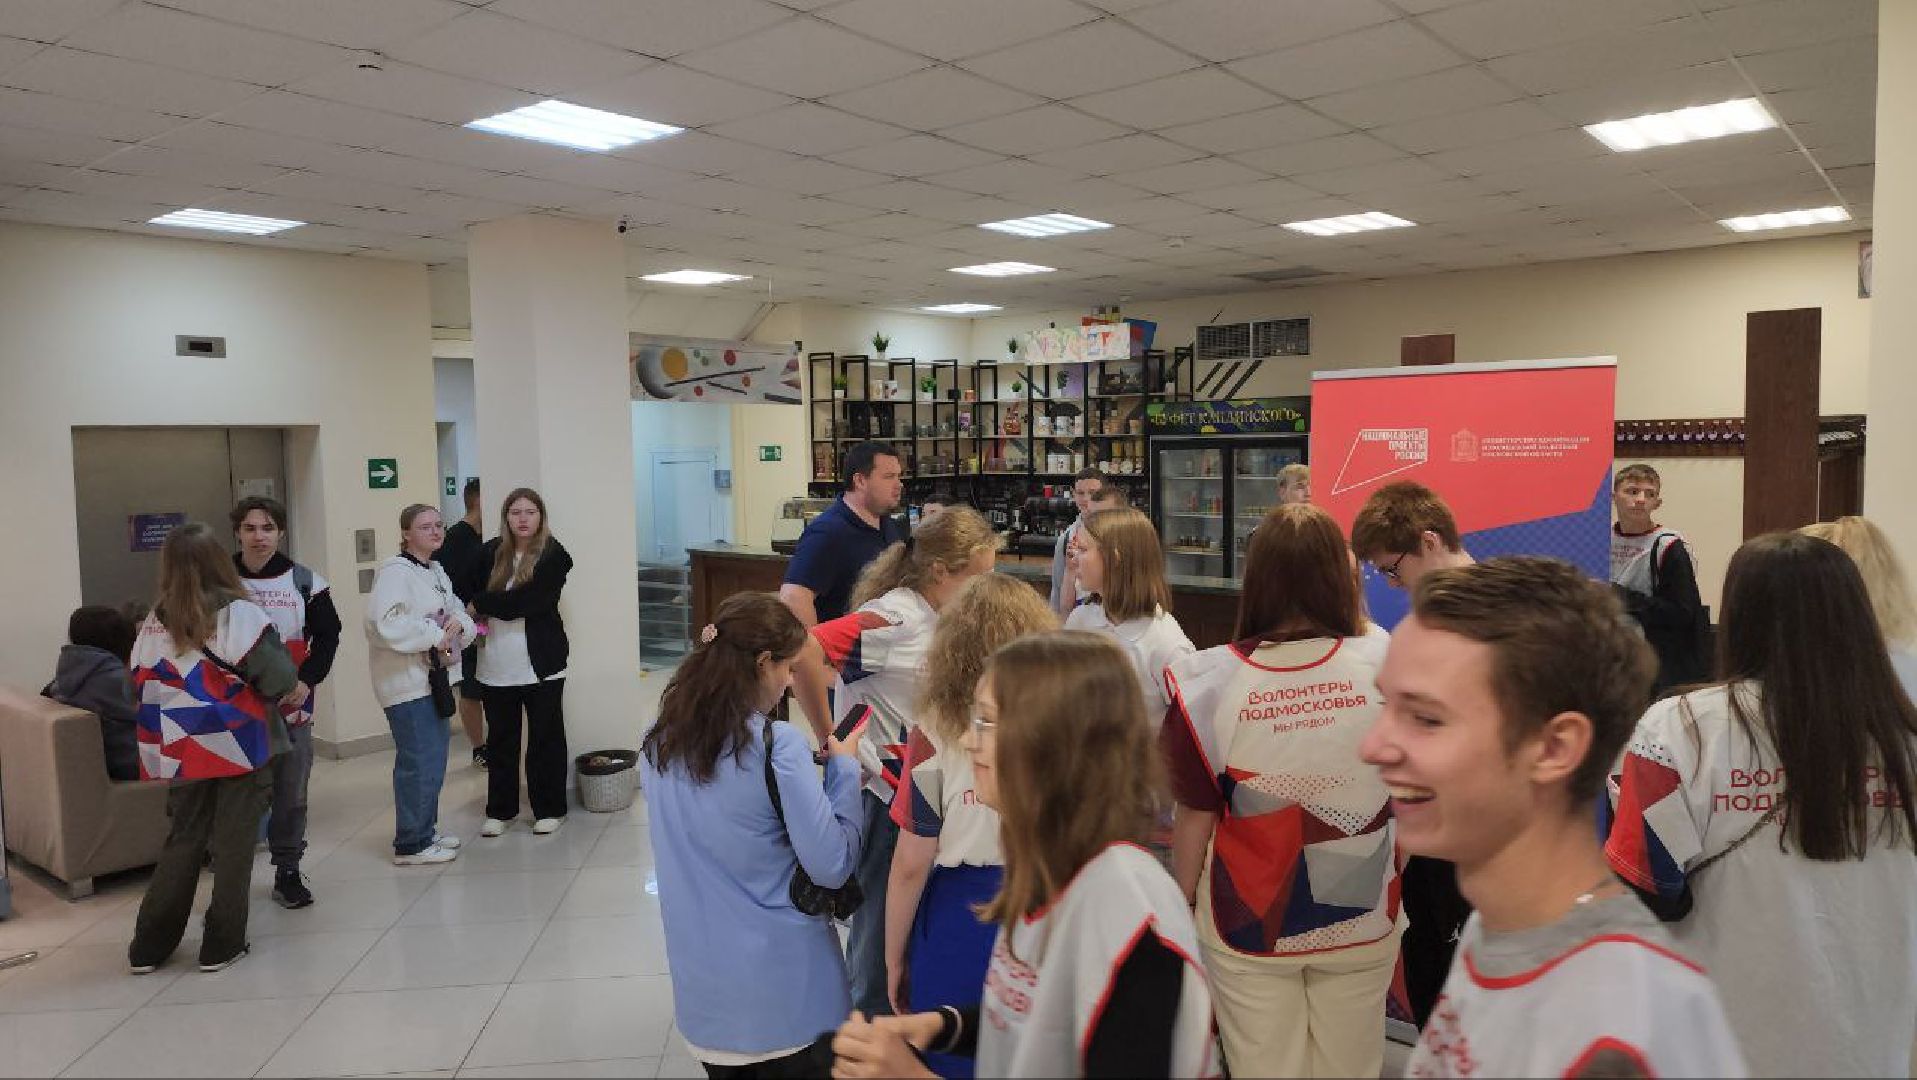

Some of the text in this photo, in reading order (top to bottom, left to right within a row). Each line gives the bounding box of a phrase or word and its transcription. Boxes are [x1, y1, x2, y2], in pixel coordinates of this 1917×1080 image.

[1248, 680, 1353, 705] ВОЛОНТЕРЫ
[1239, 695, 1368, 723] ПОДМОСКОВЬЯ
[1273, 716, 1336, 734] МЫ РЯДОМ
